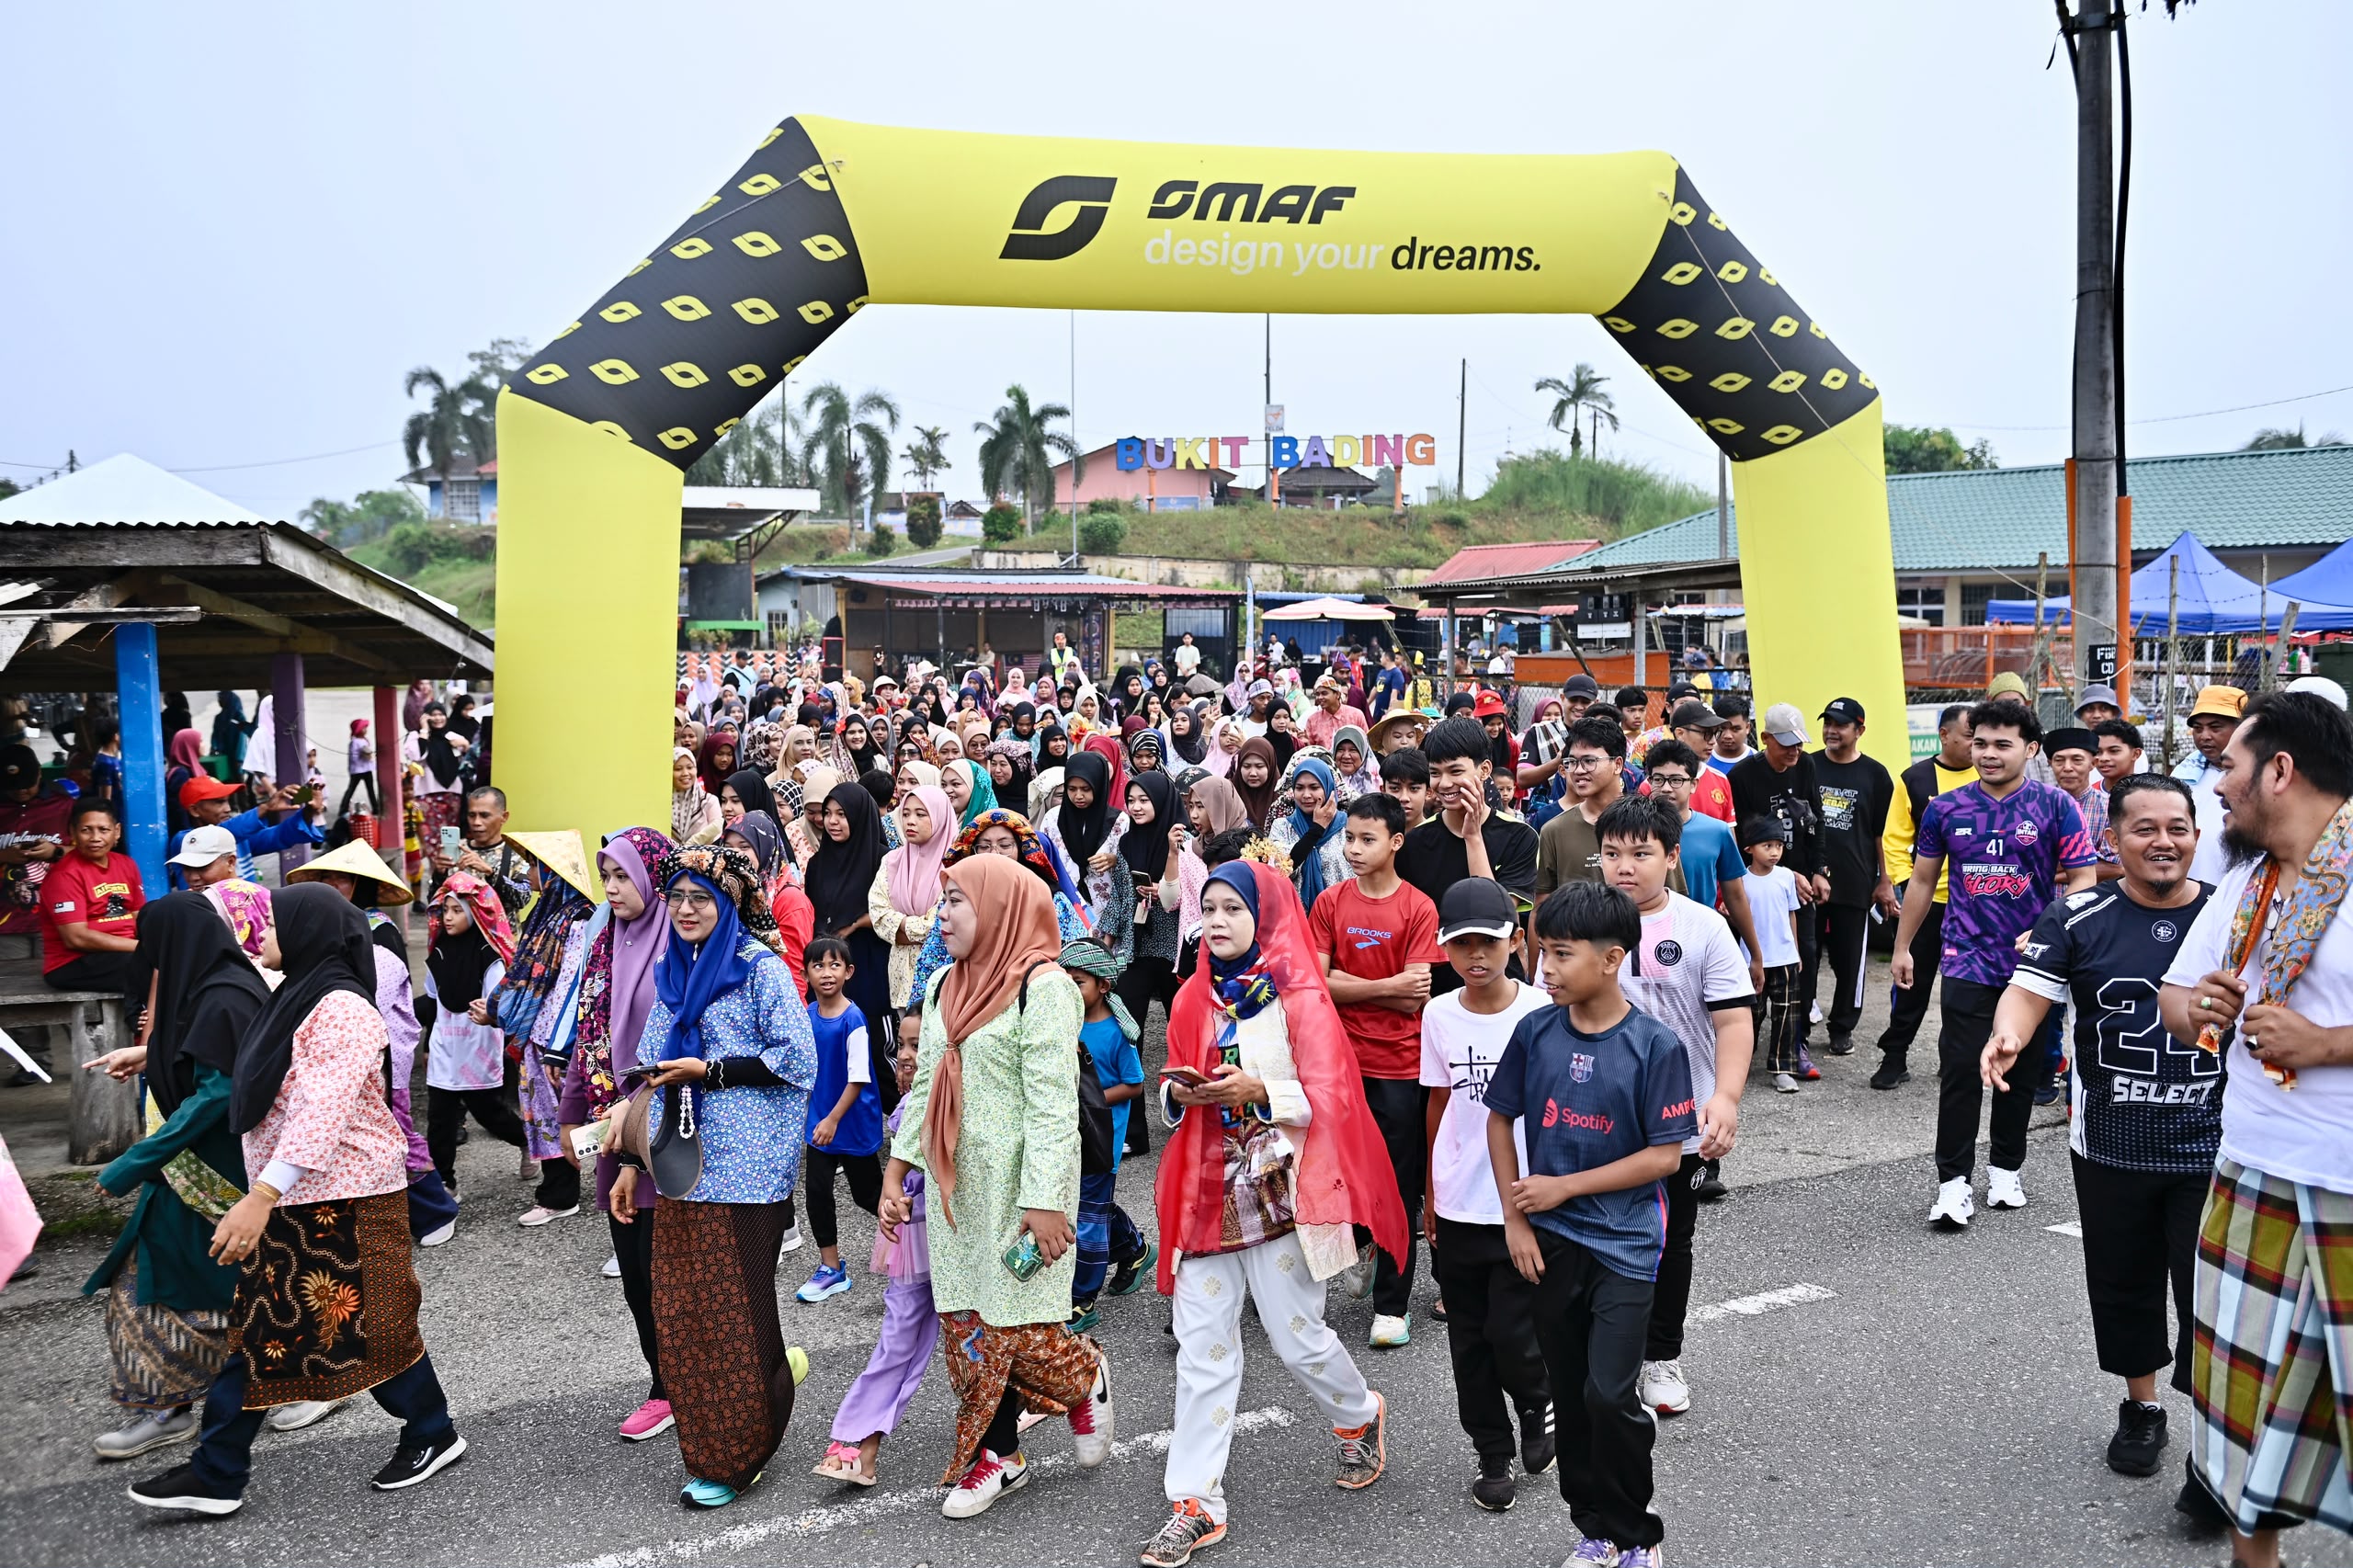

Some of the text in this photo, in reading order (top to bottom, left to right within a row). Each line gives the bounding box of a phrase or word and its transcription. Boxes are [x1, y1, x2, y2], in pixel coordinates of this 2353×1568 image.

[1147, 180, 1356, 224] SMAF
[1144, 229, 1542, 277] design your dreams.
[1116, 434, 1435, 471] BUKIT BADING
[1985, 838, 2004, 857] 41
[1961, 863, 2018, 874] BRING BACK
[1963, 872, 2034, 901] GLORY
[1347, 926, 1392, 939] BROOKS
[2109, 1074, 2220, 1109] SELECT
[1561, 1107, 1614, 1135] Spotify
